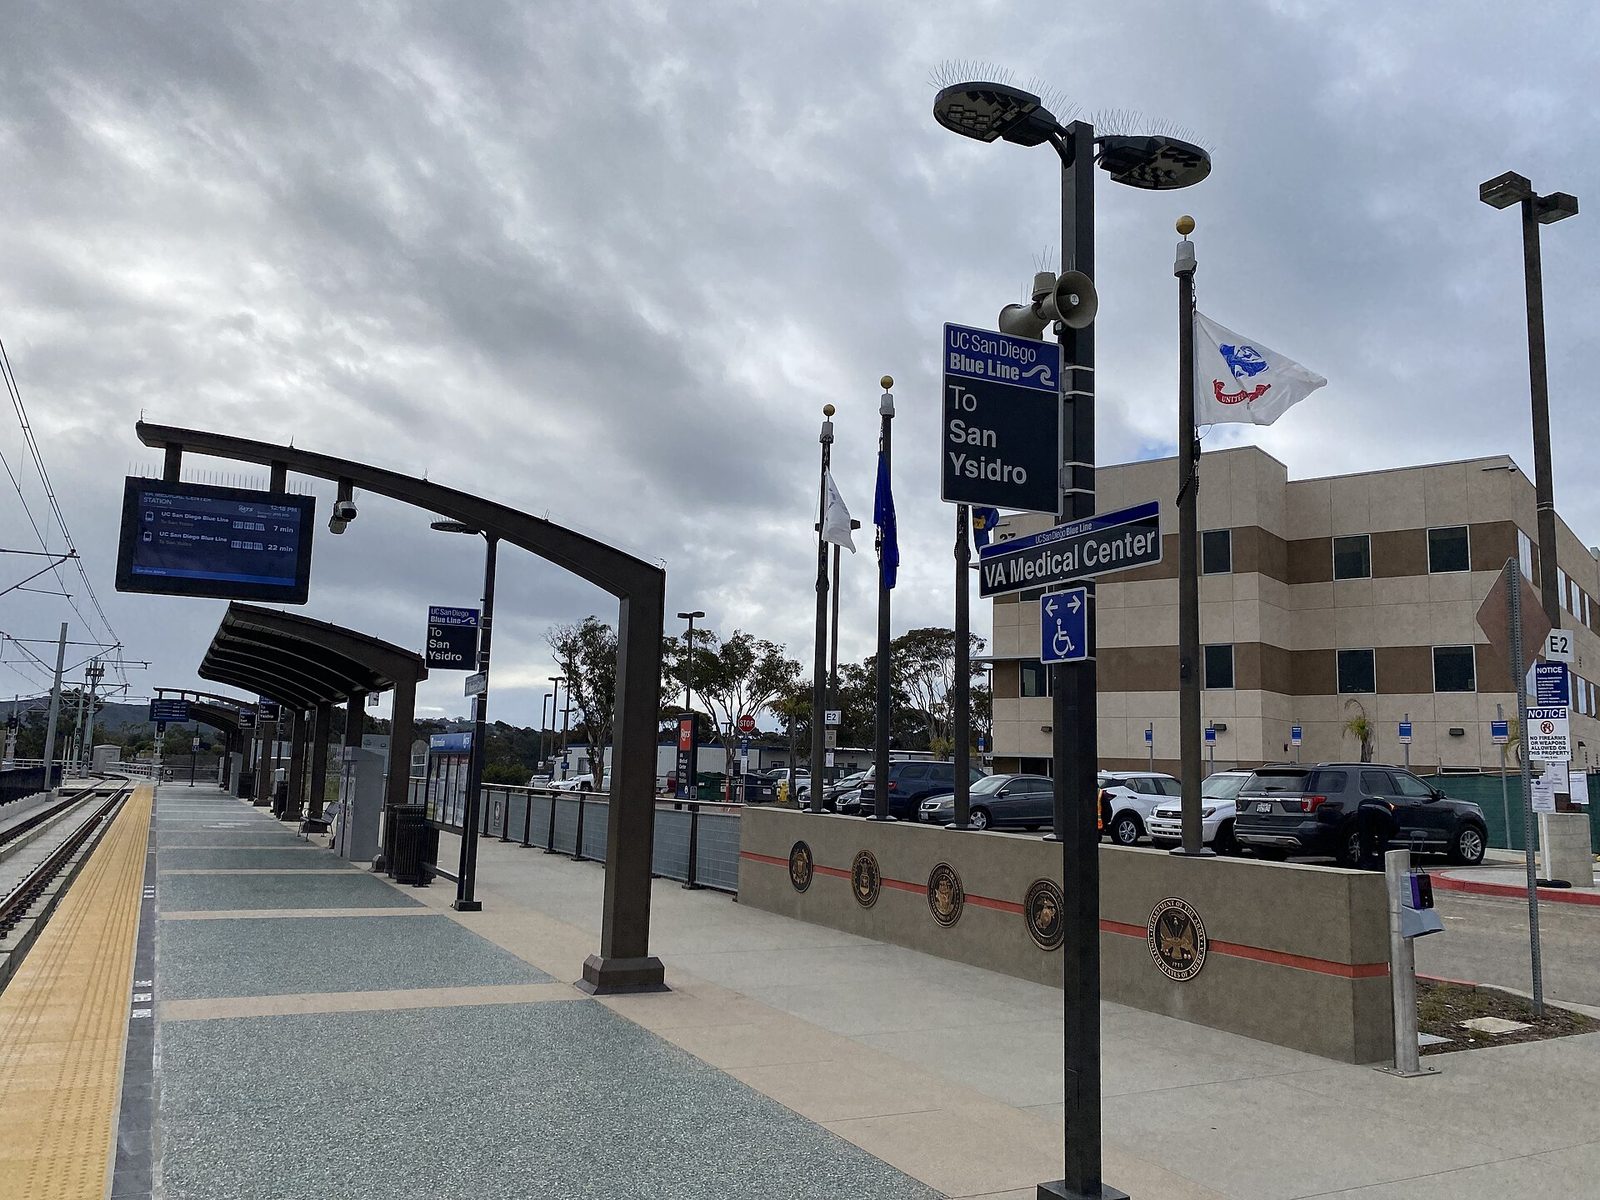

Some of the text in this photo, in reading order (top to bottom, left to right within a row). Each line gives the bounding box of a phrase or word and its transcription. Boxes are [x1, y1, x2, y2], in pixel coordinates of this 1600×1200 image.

[950, 330, 1036, 364] UC San Diego
[950, 352, 1020, 381] Blue Line
[948, 384, 977, 412] To
[949, 420, 997, 448] San
[949, 452, 1027, 485] Ysidro
[184, 513, 201, 521] Diego
[182, 533, 200, 541] Diego
[1035, 522, 1093, 544] UC San Diego Blue Line
[984, 530, 1156, 588] VA Medical Center
[430, 607, 469, 618] UC San Diego
[430, 615, 461, 624] Blue Line
[429, 626, 442, 637] To
[429, 639, 450, 649] San
[1549, 635, 1569, 654] E2
[428, 651, 462, 661] Ysidro
[1536, 666, 1563, 674] NOTICE
[826, 713, 837, 721] E2
[1527, 708, 1566, 718] NOTICE
[739, 719, 754, 728] STOP
